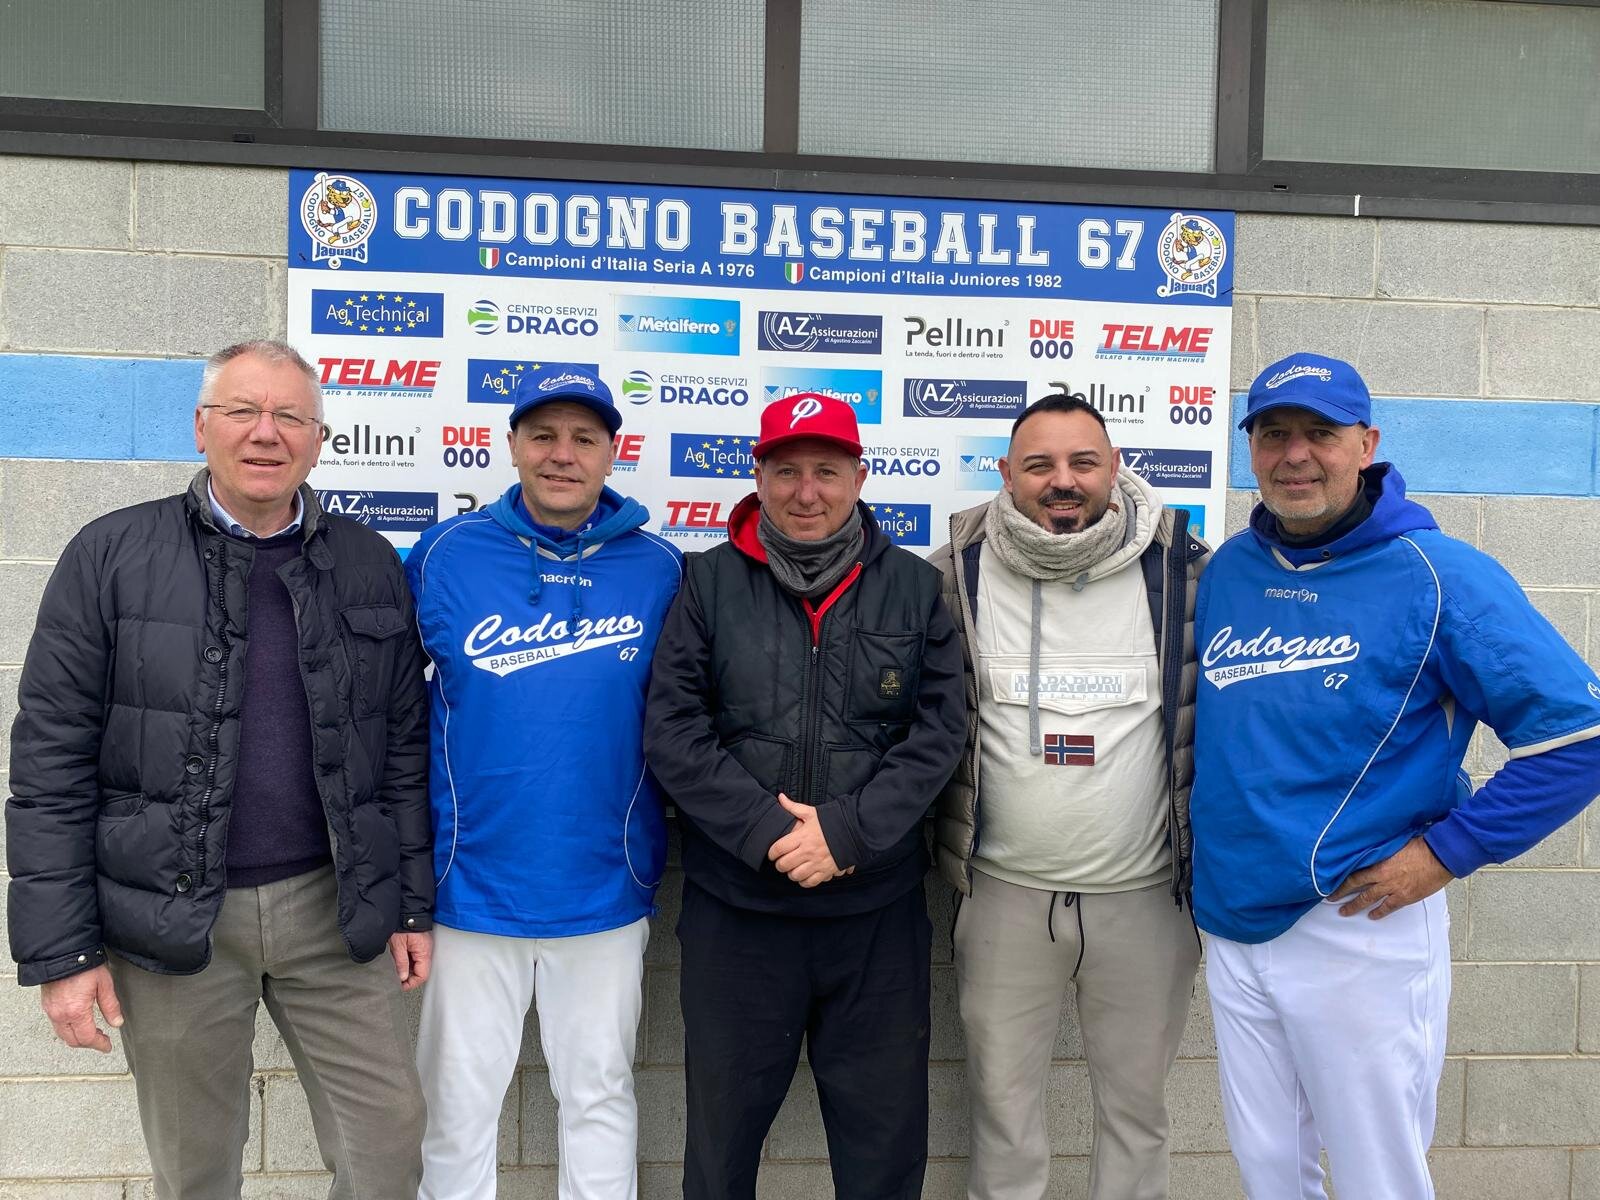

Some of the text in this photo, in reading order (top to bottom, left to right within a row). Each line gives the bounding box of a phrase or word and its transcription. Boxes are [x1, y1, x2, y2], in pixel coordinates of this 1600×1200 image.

[307, 192, 326, 238] CODOGNO
[342, 208, 372, 244] BASEBALL
[393, 186, 1144, 271] CODOGNO BASEBALL 67
[1163, 232, 1179, 274] CODOGNO
[1193, 246, 1221, 280] BASEBALL
[505, 252, 586, 270] Campioni
[653, 258, 696, 274] Seria
[700, 262, 713, 275] A
[718, 262, 755, 278] 1976
[809, 266, 886, 287] Campioni
[949, 271, 1021, 288] Juniores
[1025, 273, 1063, 288] 1982
[326, 304, 430, 324] Ag Technical
[507, 304, 598, 317] CENTRO SERVIZI
[507, 316, 599, 337] DRAGO
[638, 316, 720, 335] Metalferro
[777, 316, 878, 338] AZ Assicurazioni
[904, 316, 1004, 347] Pellini
[1029, 319, 1074, 339] DUE
[1102, 323, 1213, 352] TELME
[318, 357, 441, 388] TELME
[482, 373, 504, 393] Ag
[660, 374, 748, 386] CENTRO SERVIZI
[660, 386, 748, 406] DRAGO
[922, 383, 1023, 403] AZ Assicurazioni
[1169, 385, 1213, 405] DUE
[790, 398, 823, 429] P
[443, 426, 491, 447] DUE
[684, 447, 756, 467] Ag Techn
[863, 446, 940, 457] ENTRO SERVIZI
[343, 458, 360, 466] fuori
[367, 459, 390, 467] dentro
[1143, 462, 1208, 473] Assicurazioni
[327, 494, 434, 516] AZ Assicurazioni
[464, 612, 643, 657] Codogno
[1202, 626, 1360, 668] Codogno
[490, 647, 561, 670] BASEBALL
[1214, 663, 1267, 682] BASEBALL
[1016, 675, 1120, 692] NPAPIJRI
